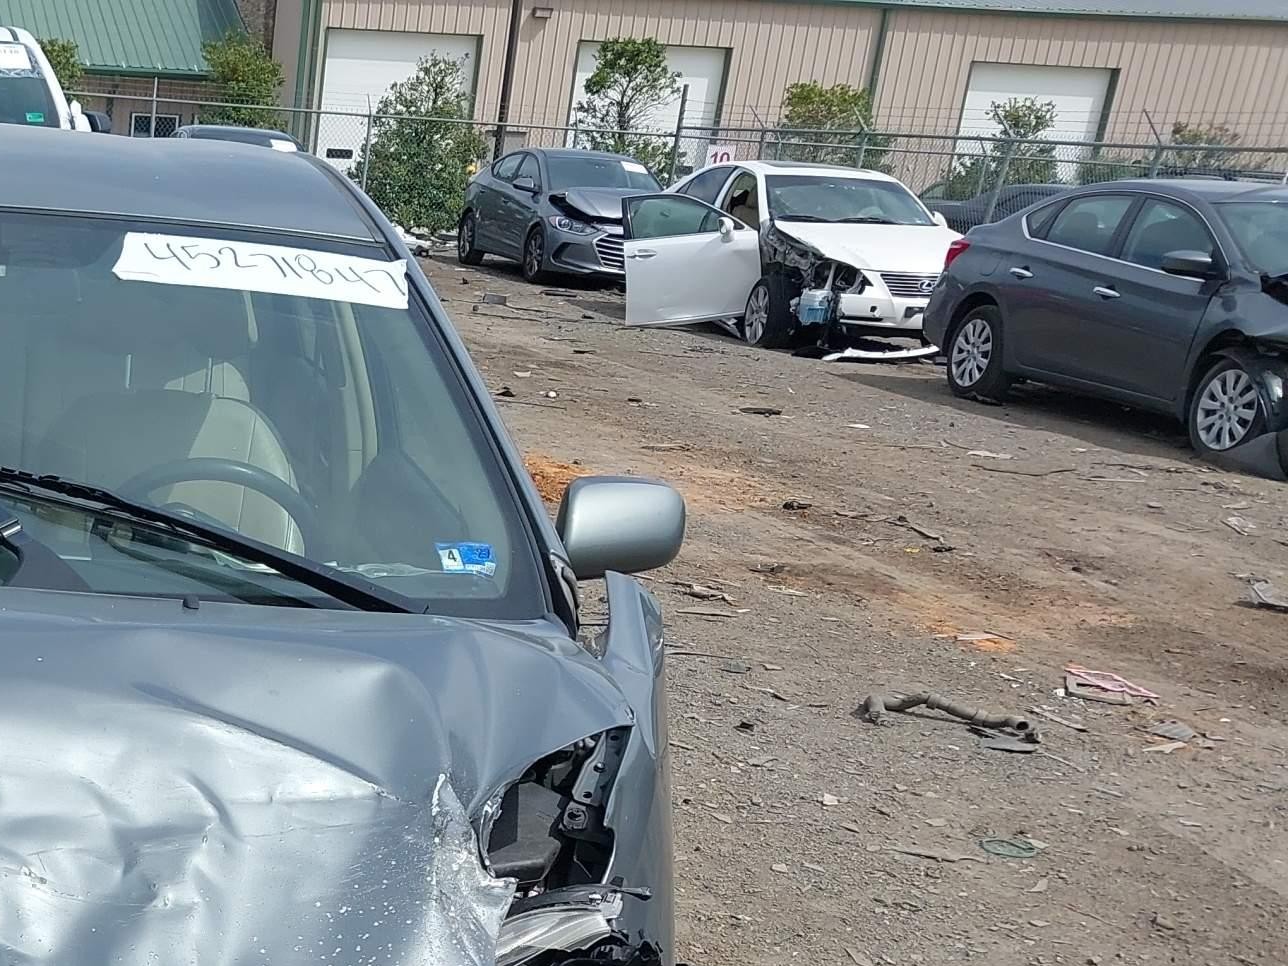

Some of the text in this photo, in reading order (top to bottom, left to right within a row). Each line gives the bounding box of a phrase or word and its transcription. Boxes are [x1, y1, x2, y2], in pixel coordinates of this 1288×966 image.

[710, 151, 731, 164] 10
[143, 242, 406, 297] 45271847
[447, 549, 458, 562] 4
